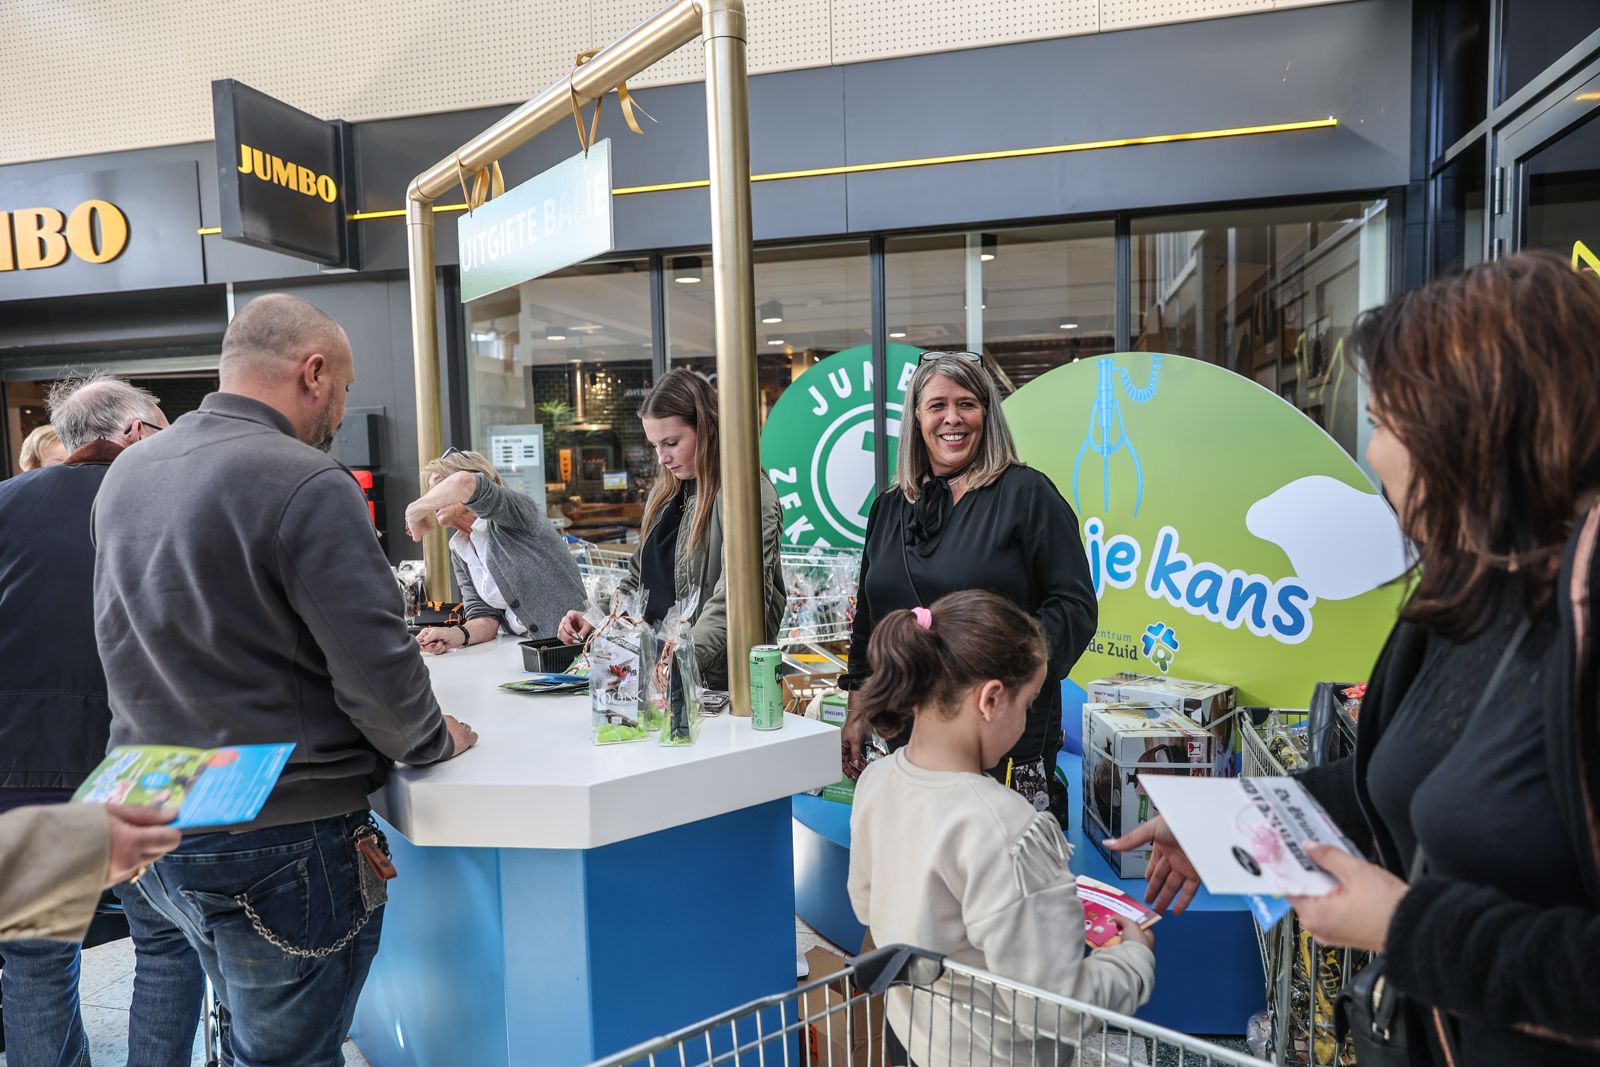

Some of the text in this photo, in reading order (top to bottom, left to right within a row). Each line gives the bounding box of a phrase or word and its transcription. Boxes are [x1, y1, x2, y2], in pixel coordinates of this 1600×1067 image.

[237, 144, 337, 203] JUMBO
[460, 171, 608, 272] UITGIFTE BALIE
[1089, 522, 1309, 637] je kans
[1087, 638, 1138, 661] de Zuid
[824, 710, 844, 718] PHILIPS
